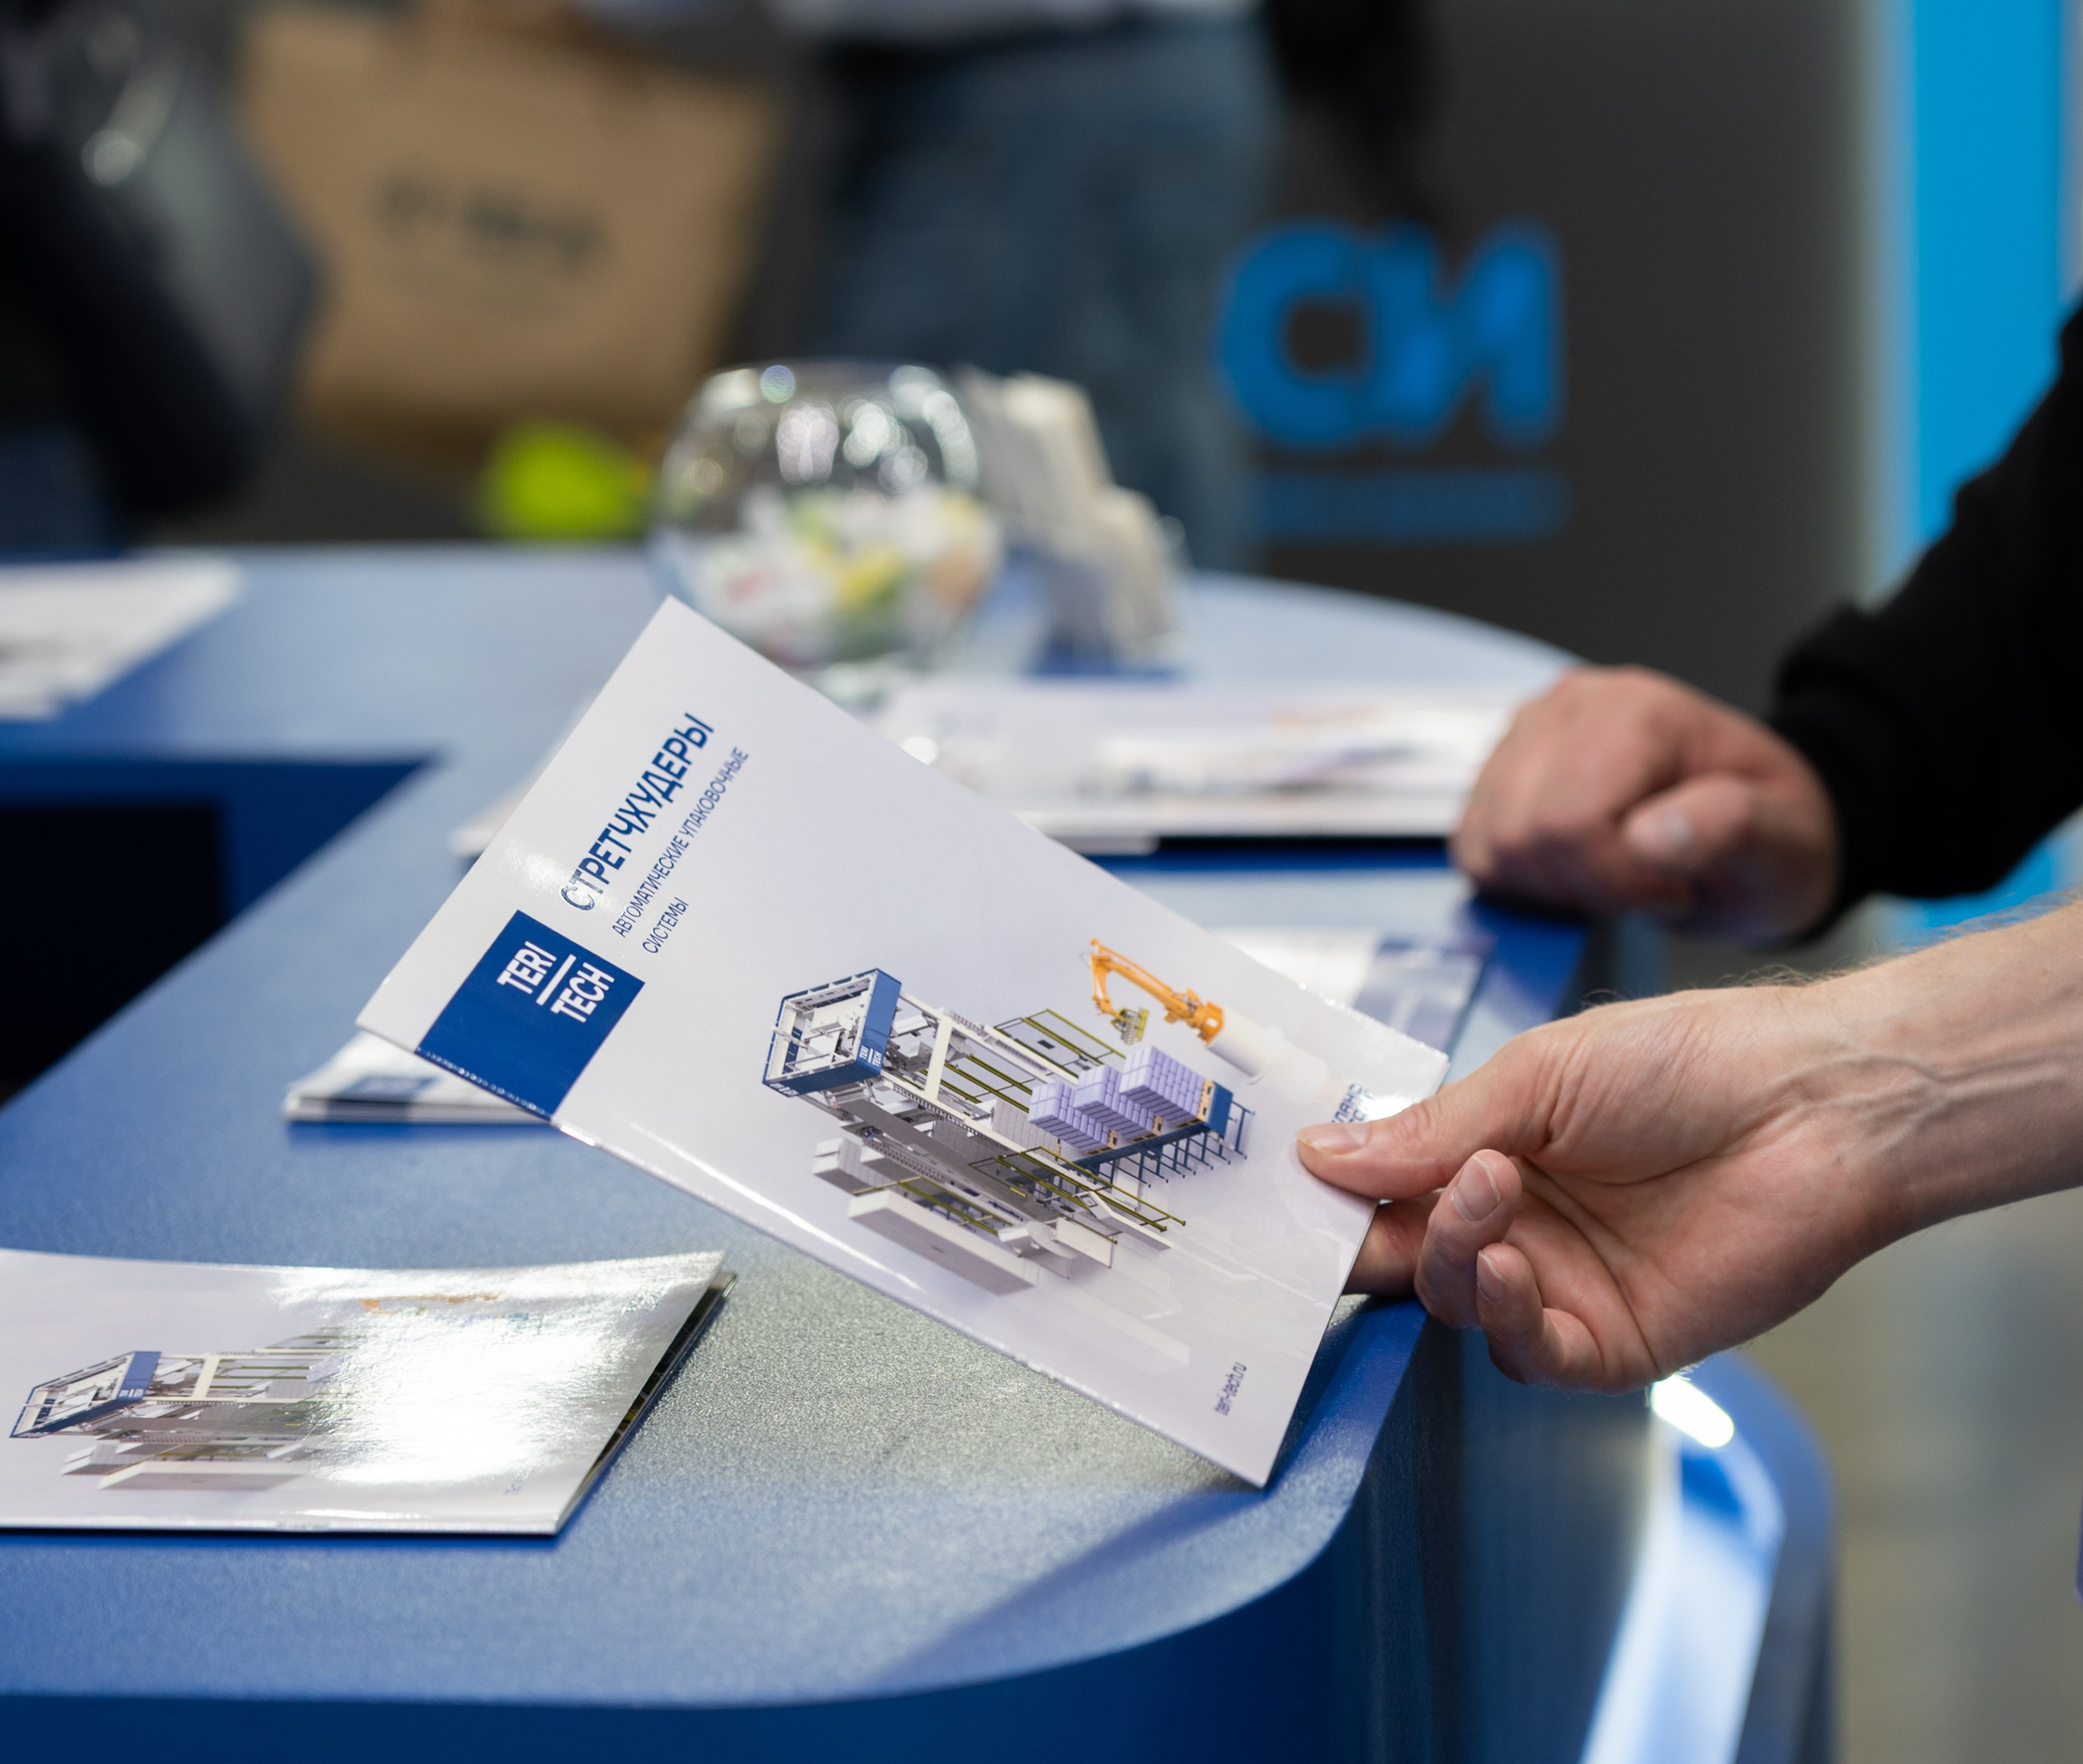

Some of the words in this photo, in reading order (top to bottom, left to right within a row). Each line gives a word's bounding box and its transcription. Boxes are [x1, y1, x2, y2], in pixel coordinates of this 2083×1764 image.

[560, 712, 714, 911] СТРЕТЧХУДЕРЫ
[612, 835, 689, 938] АВТОМАТИЧЕСКИЕ
[679, 746, 749, 839] УПАКОВОЧНЫЕ
[642, 897, 689, 954] СИСТЕМЫ
[496, 941, 557, 994] TERI
[550, 962, 615, 1023] TECH
